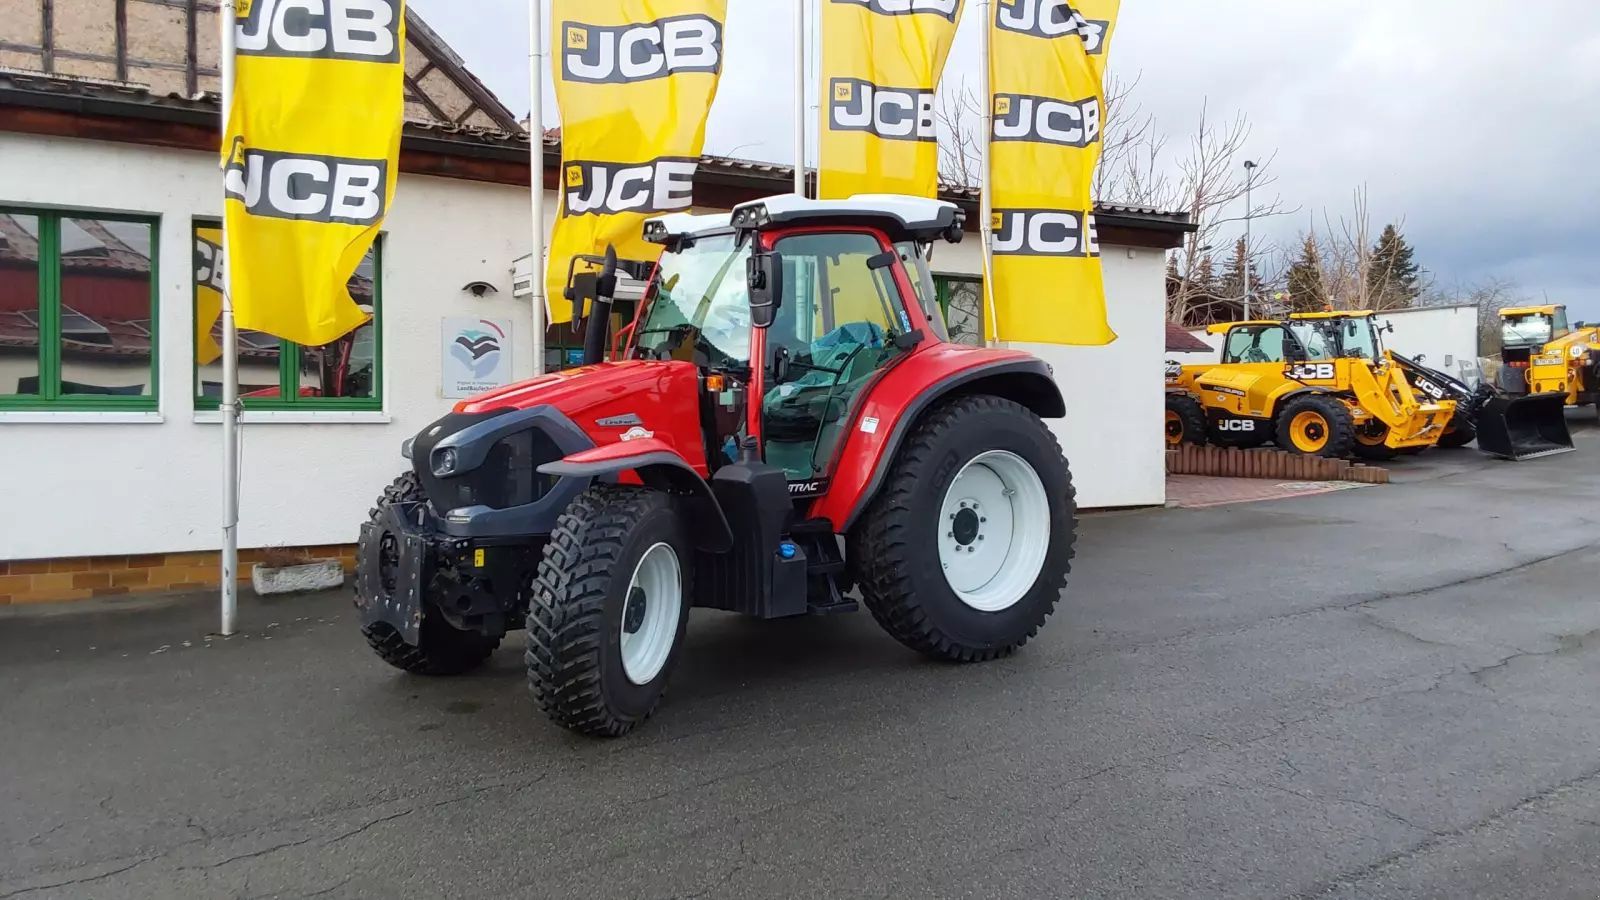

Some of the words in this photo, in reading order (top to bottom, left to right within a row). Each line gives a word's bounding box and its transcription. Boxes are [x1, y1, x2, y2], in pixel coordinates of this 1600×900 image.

[566, 19, 718, 79] JCB
[993, 97, 1099, 142] JCB
[225, 154, 380, 219] JCB
[1414, 377, 1443, 399] JCB
[1218, 418, 1255, 432] JCB
